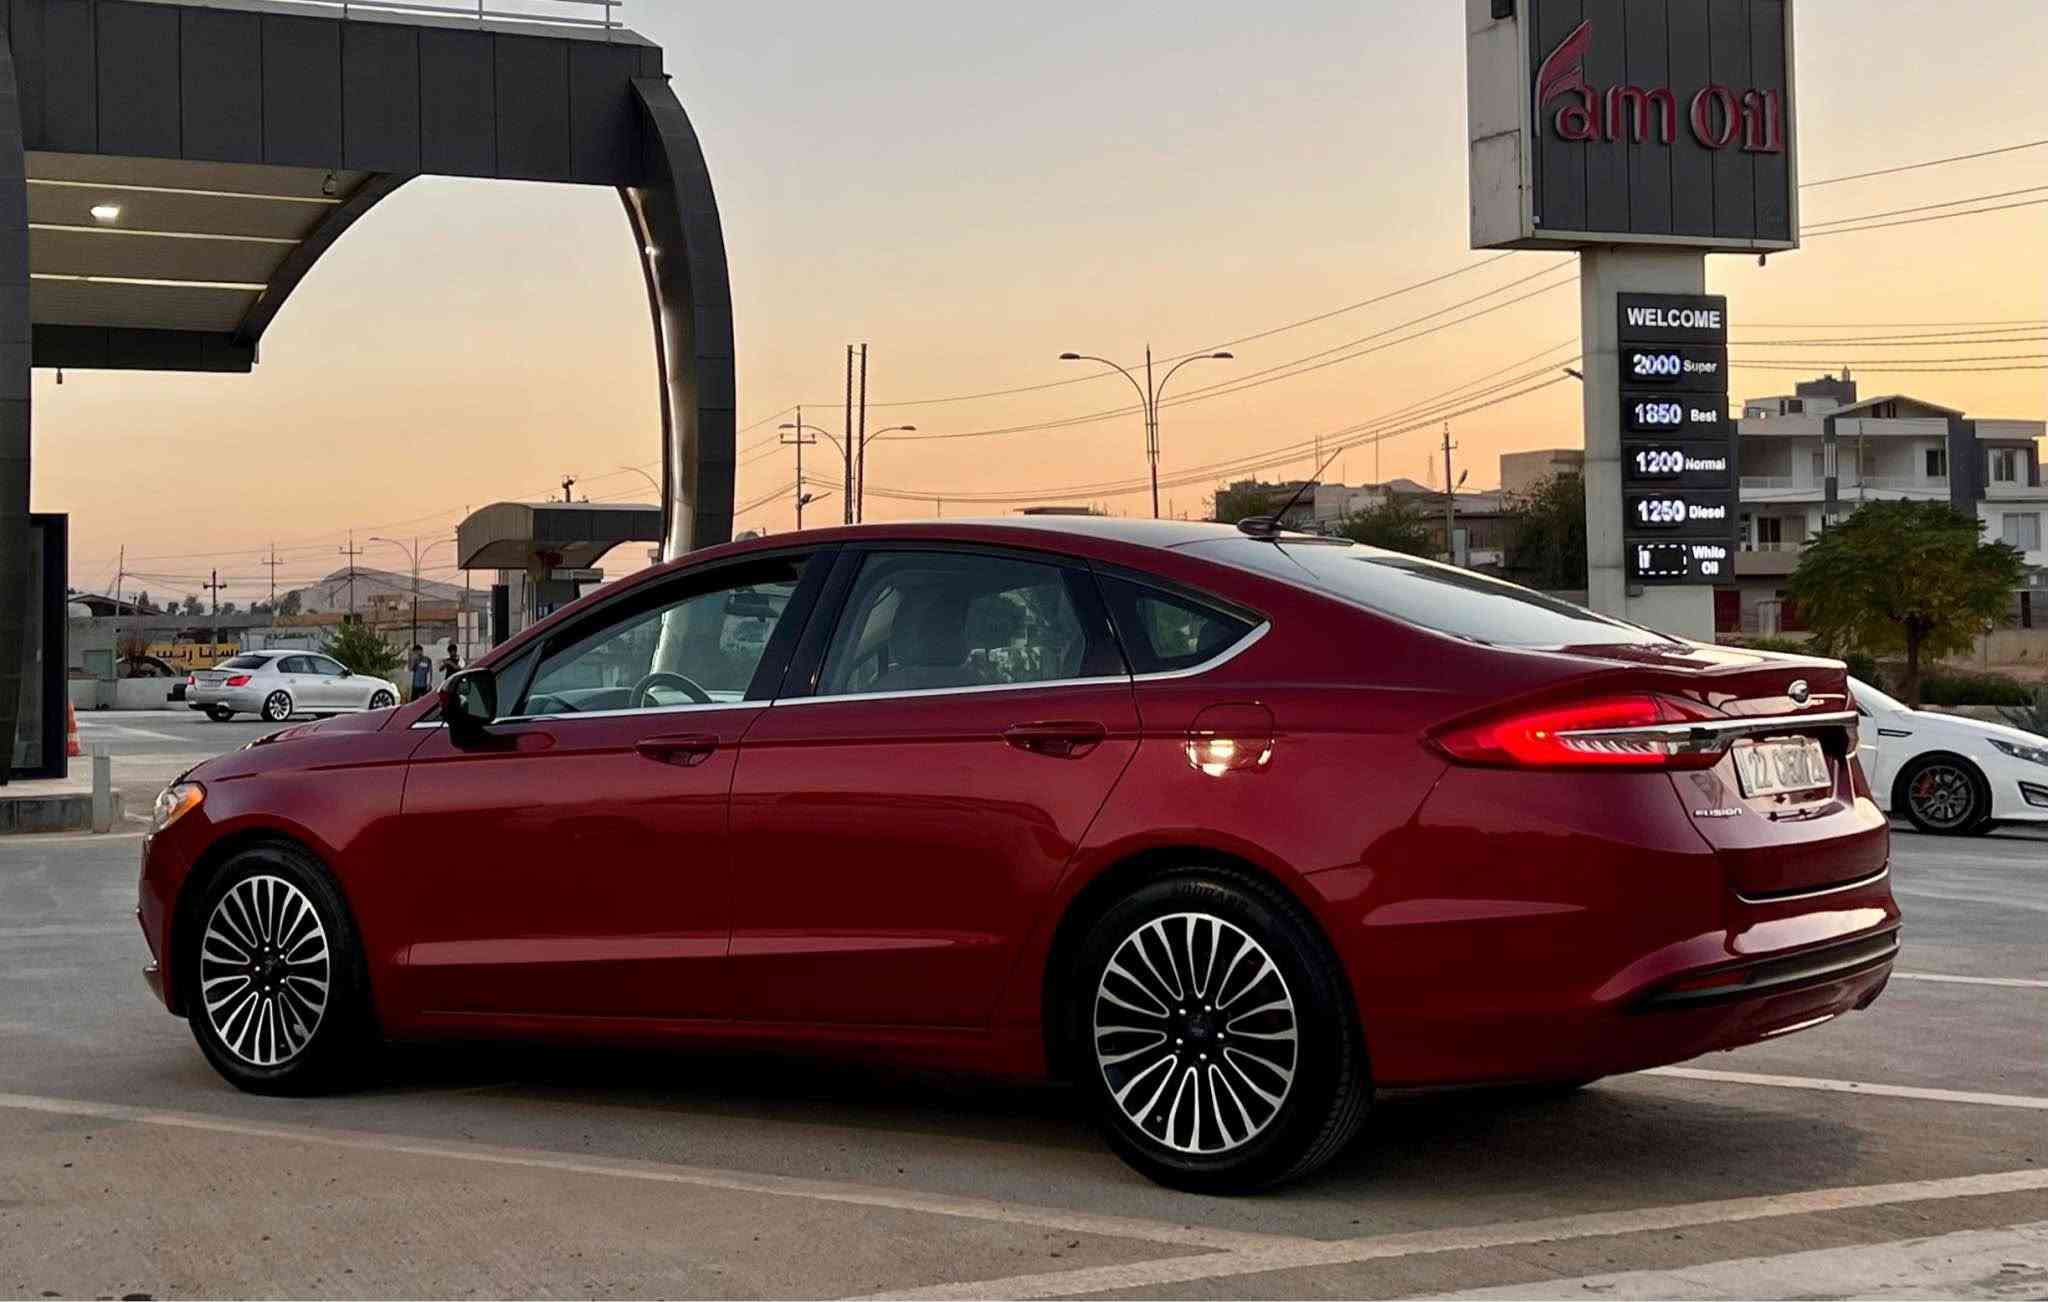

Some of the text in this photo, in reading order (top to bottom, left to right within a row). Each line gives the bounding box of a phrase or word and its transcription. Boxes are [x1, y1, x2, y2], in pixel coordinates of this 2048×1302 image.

[1690, 82, 1784, 152] Oil
[1627, 307, 1721, 329] WELCOME
[1633, 354, 1717, 376] 2000 Super
[1635, 403, 1717, 423] 1850 Best
[1636, 451, 1726, 472] 1200 Normal
[1638, 500, 1725, 522] 1250 Diesel
[1692, 545, 1726, 559] White
[1701, 560, 1719, 575] Oil
